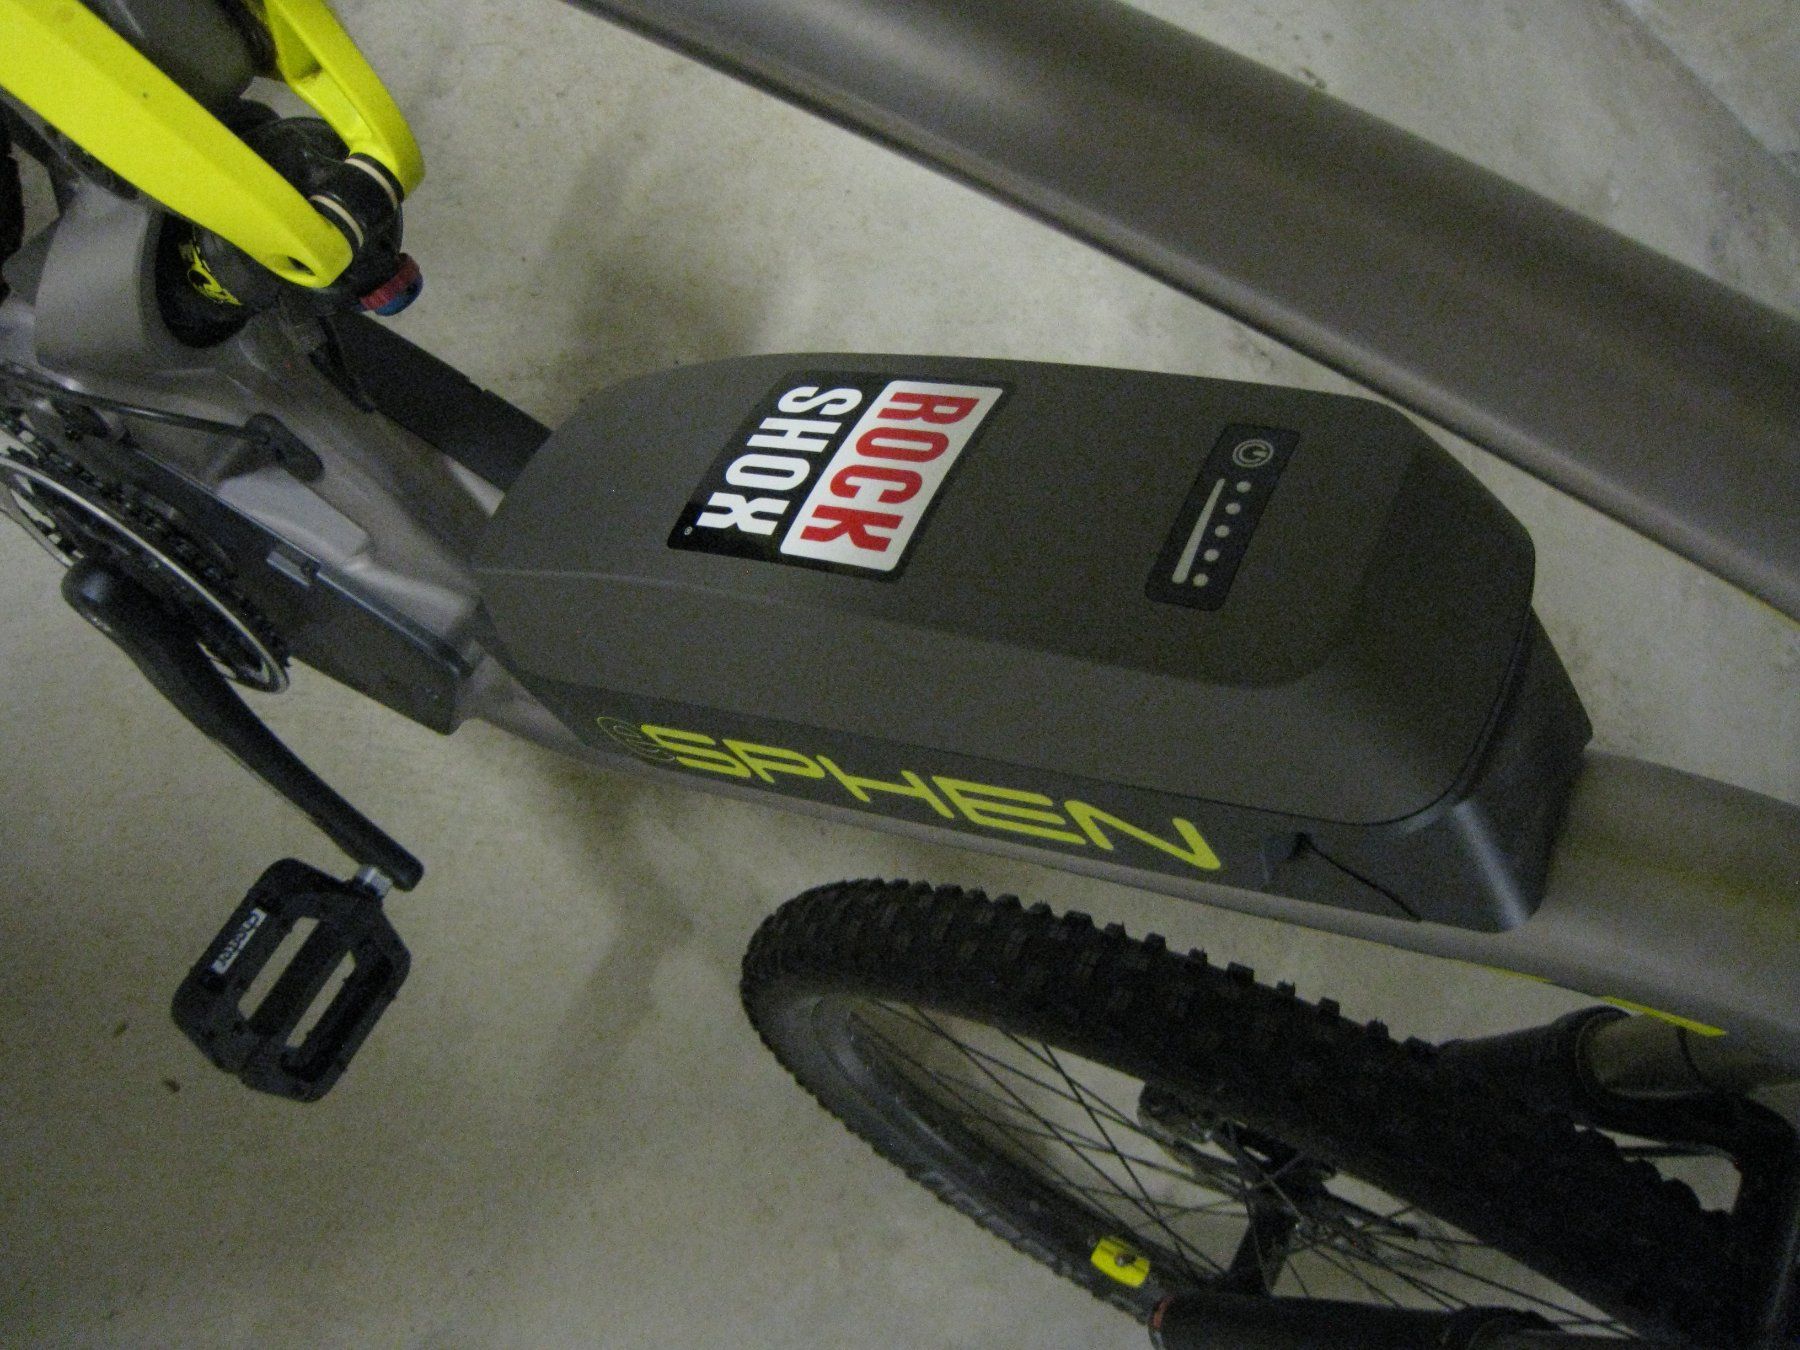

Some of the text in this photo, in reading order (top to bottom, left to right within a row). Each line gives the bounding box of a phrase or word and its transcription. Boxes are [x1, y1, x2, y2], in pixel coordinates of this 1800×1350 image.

[696, 386, 863, 536] SHOX
[800, 392, 980, 552] ROCK
[641, 724, 1221, 870] SPHEN
